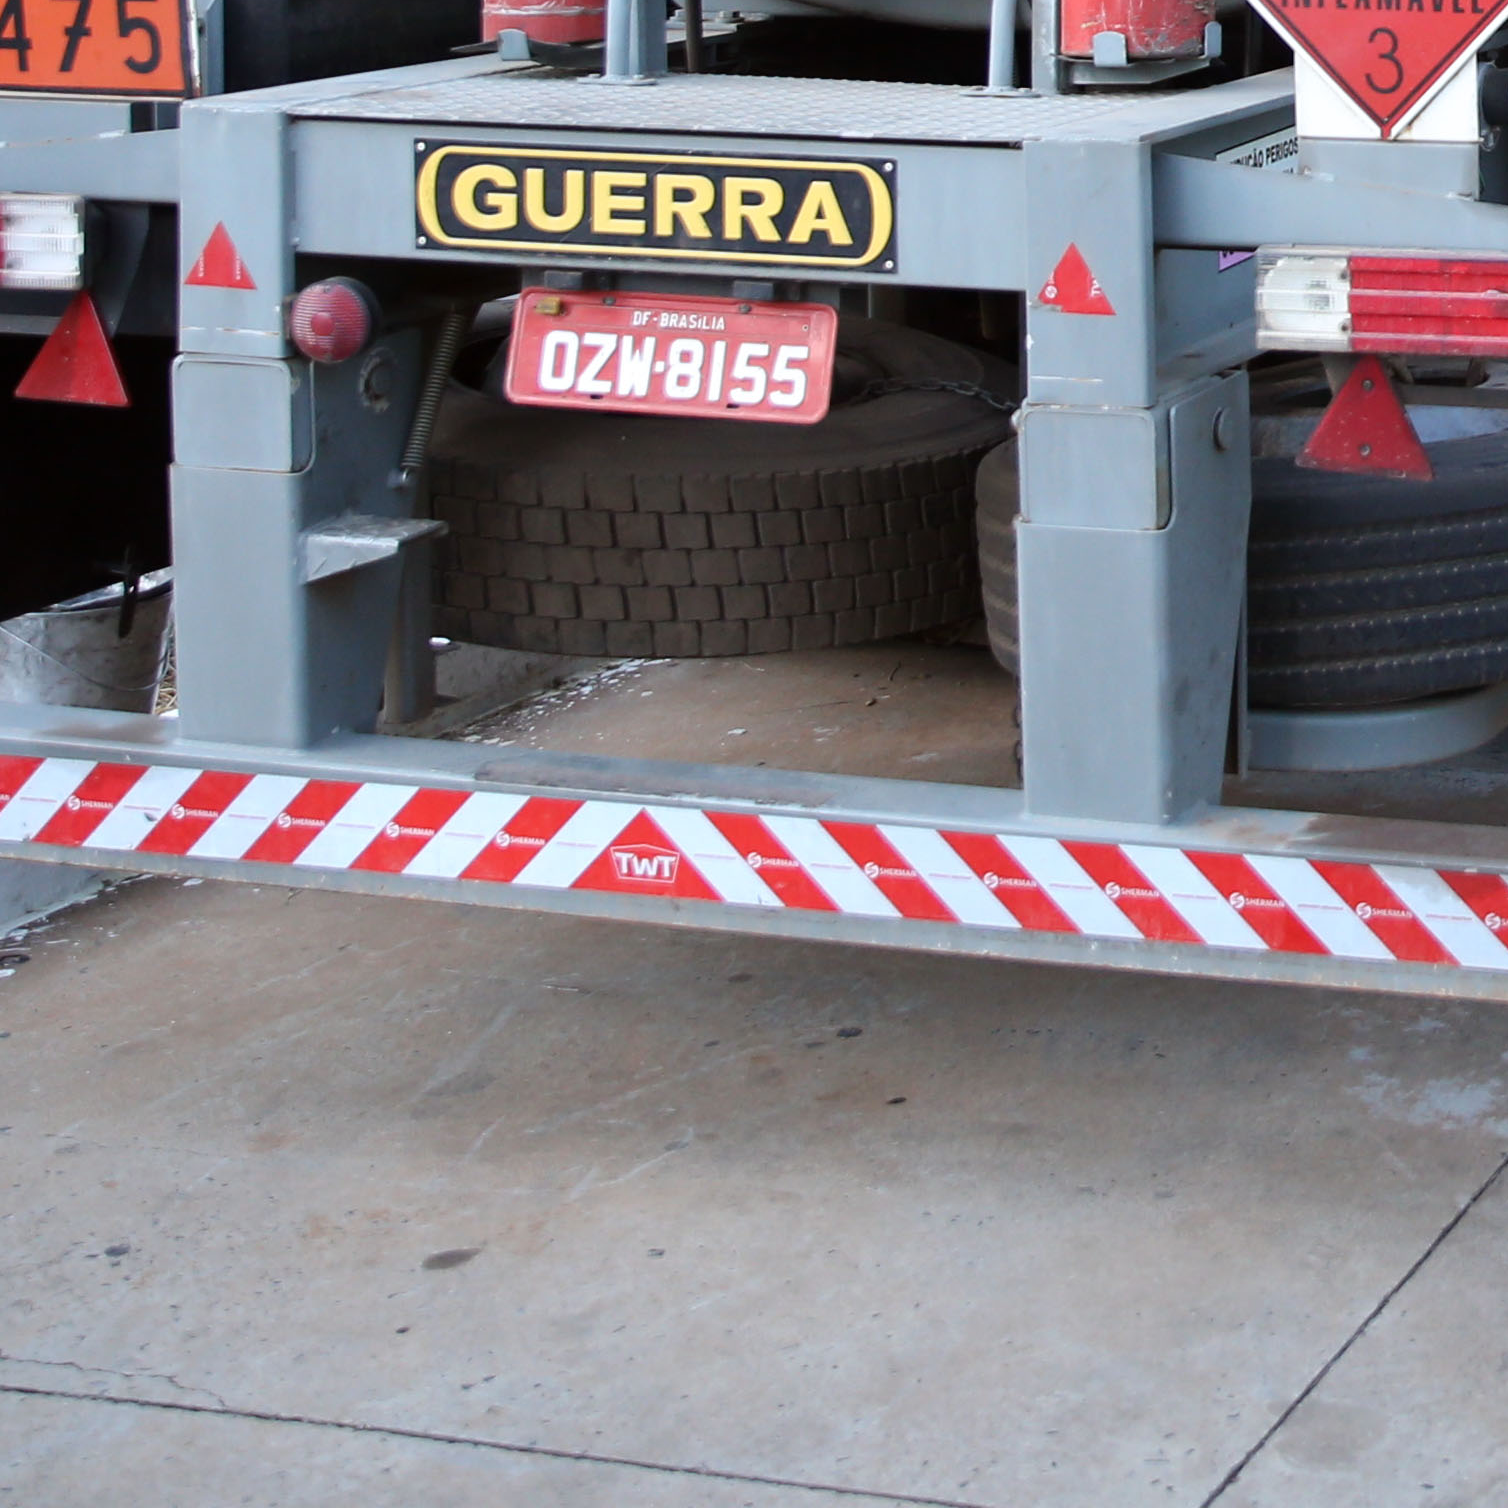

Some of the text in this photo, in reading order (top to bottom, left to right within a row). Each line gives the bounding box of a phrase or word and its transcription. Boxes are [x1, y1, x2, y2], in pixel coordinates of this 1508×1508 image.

[1364, 27, 1404, 94] 3
[1266, 136, 1299, 165] PERIGOS
[450, 163, 854, 247] GUERRA
[614, 851, 677, 878] TWT
[762, 857, 799, 868] SHERMAN
[879, 867, 917, 878] SHERMAN
[999, 877, 1038, 889] SHERMAN
[1120, 887, 1160, 898] SHERMAN
[1245, 898, 1285, 909] SHERMAN
[1371, 907, 1413, 919] SHERMAN
